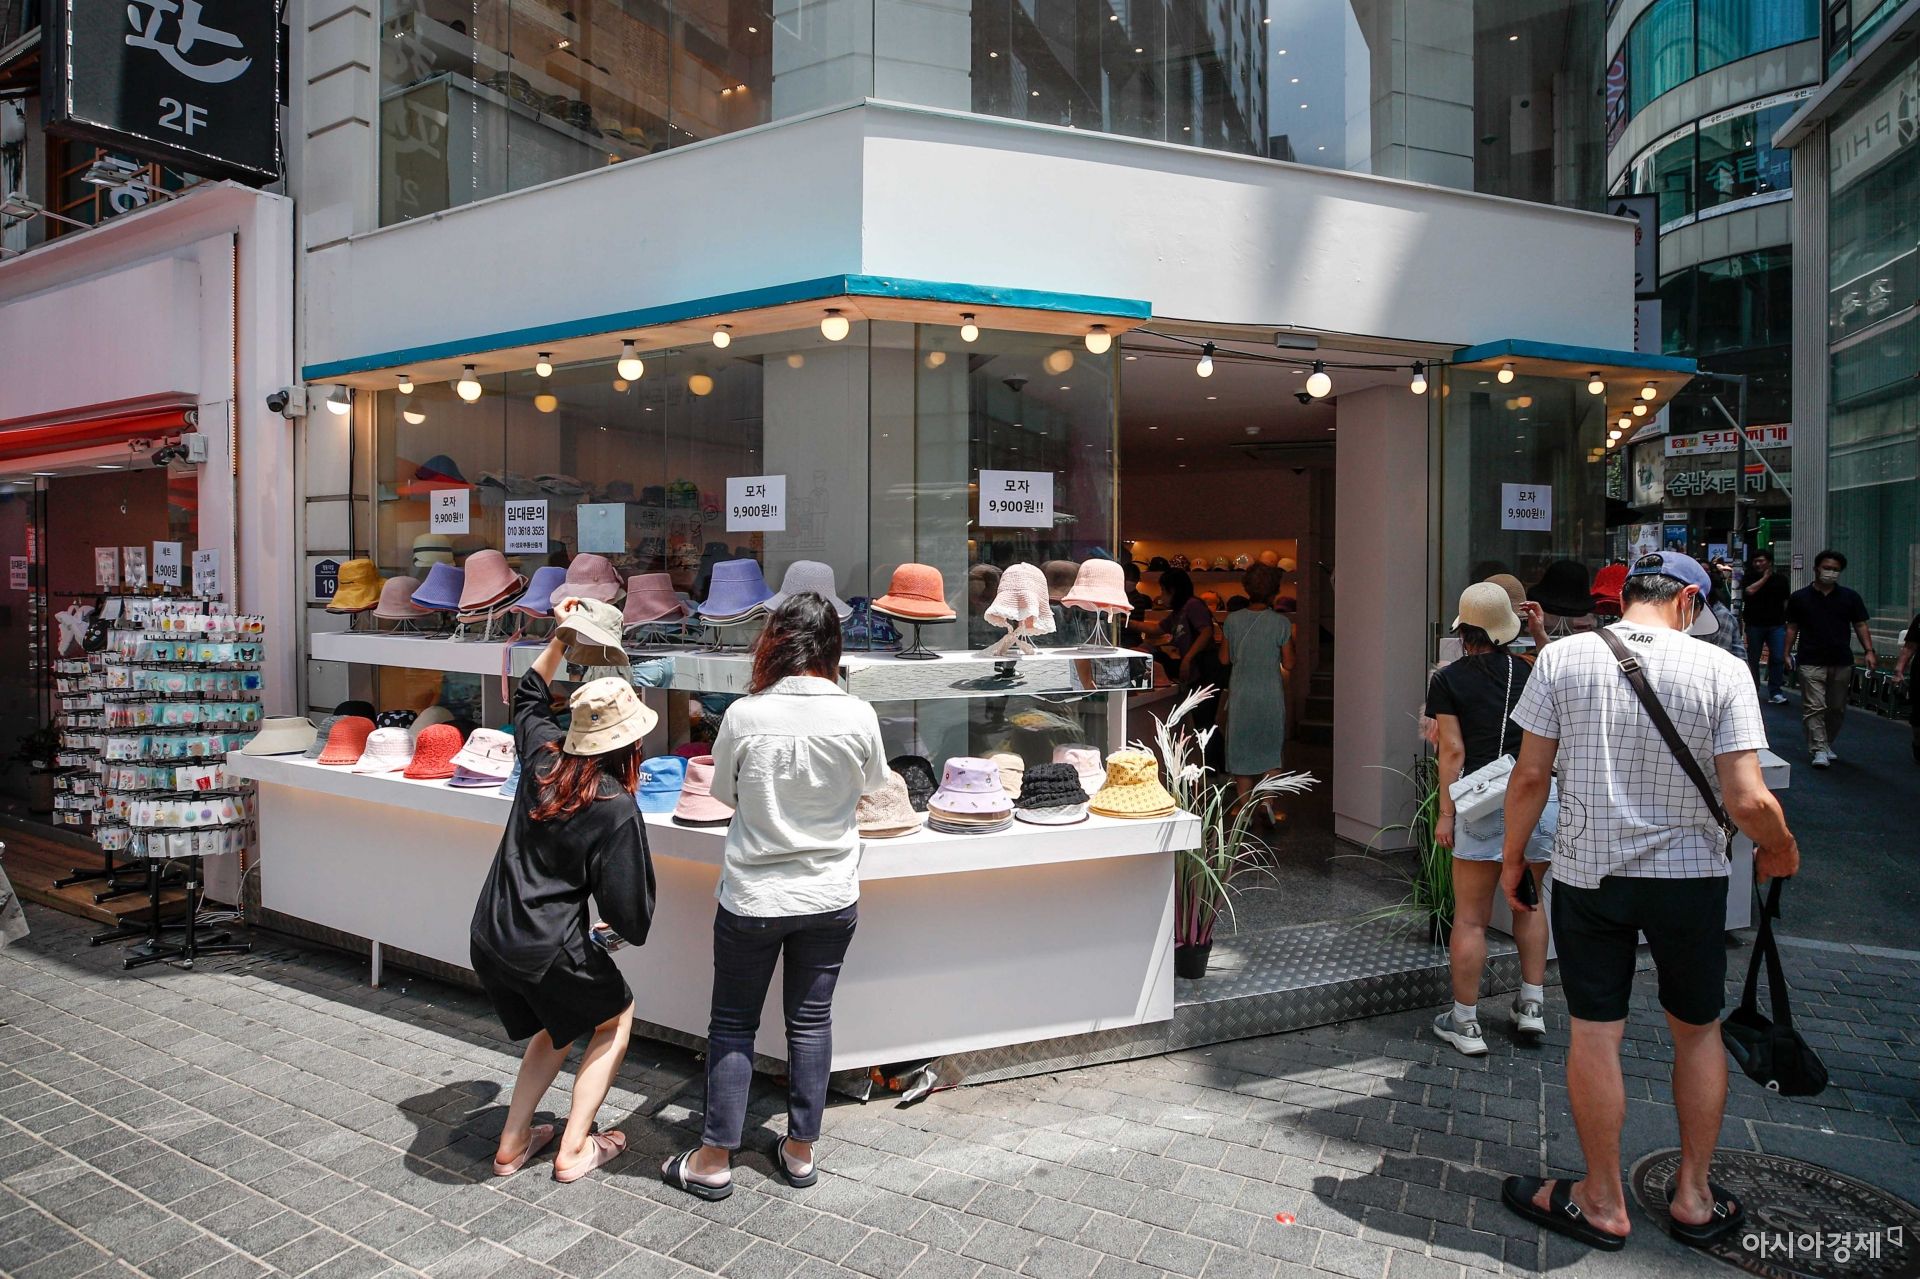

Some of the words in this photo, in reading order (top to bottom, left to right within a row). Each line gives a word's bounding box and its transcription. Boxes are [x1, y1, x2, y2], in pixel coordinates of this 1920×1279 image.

[158, 97, 208, 136] 2F
[1004, 479, 1030, 494] 모자
[1667, 468, 1766, 496] 순남시기
[745, 484, 766, 498] 모자
[1519, 491, 1536, 503] 모자
[442, 496, 456, 507] 모자
[989, 499, 1044, 514] 9,900원!!
[434, 512, 464, 523] 9,900원!!
[507, 505, 545, 521] 임대문의
[733, 504, 777, 518] 9,900원!!
[1508, 508, 1545, 519] 9,900원!!
[507, 526, 517, 536] 010
[518, 526, 531, 536] 3618
[531, 526, 545, 536] 3525
[154, 564, 178, 578] 4,900원
[323, 579, 335, 594] 19
[1628, 633, 1654, 644] AAR
